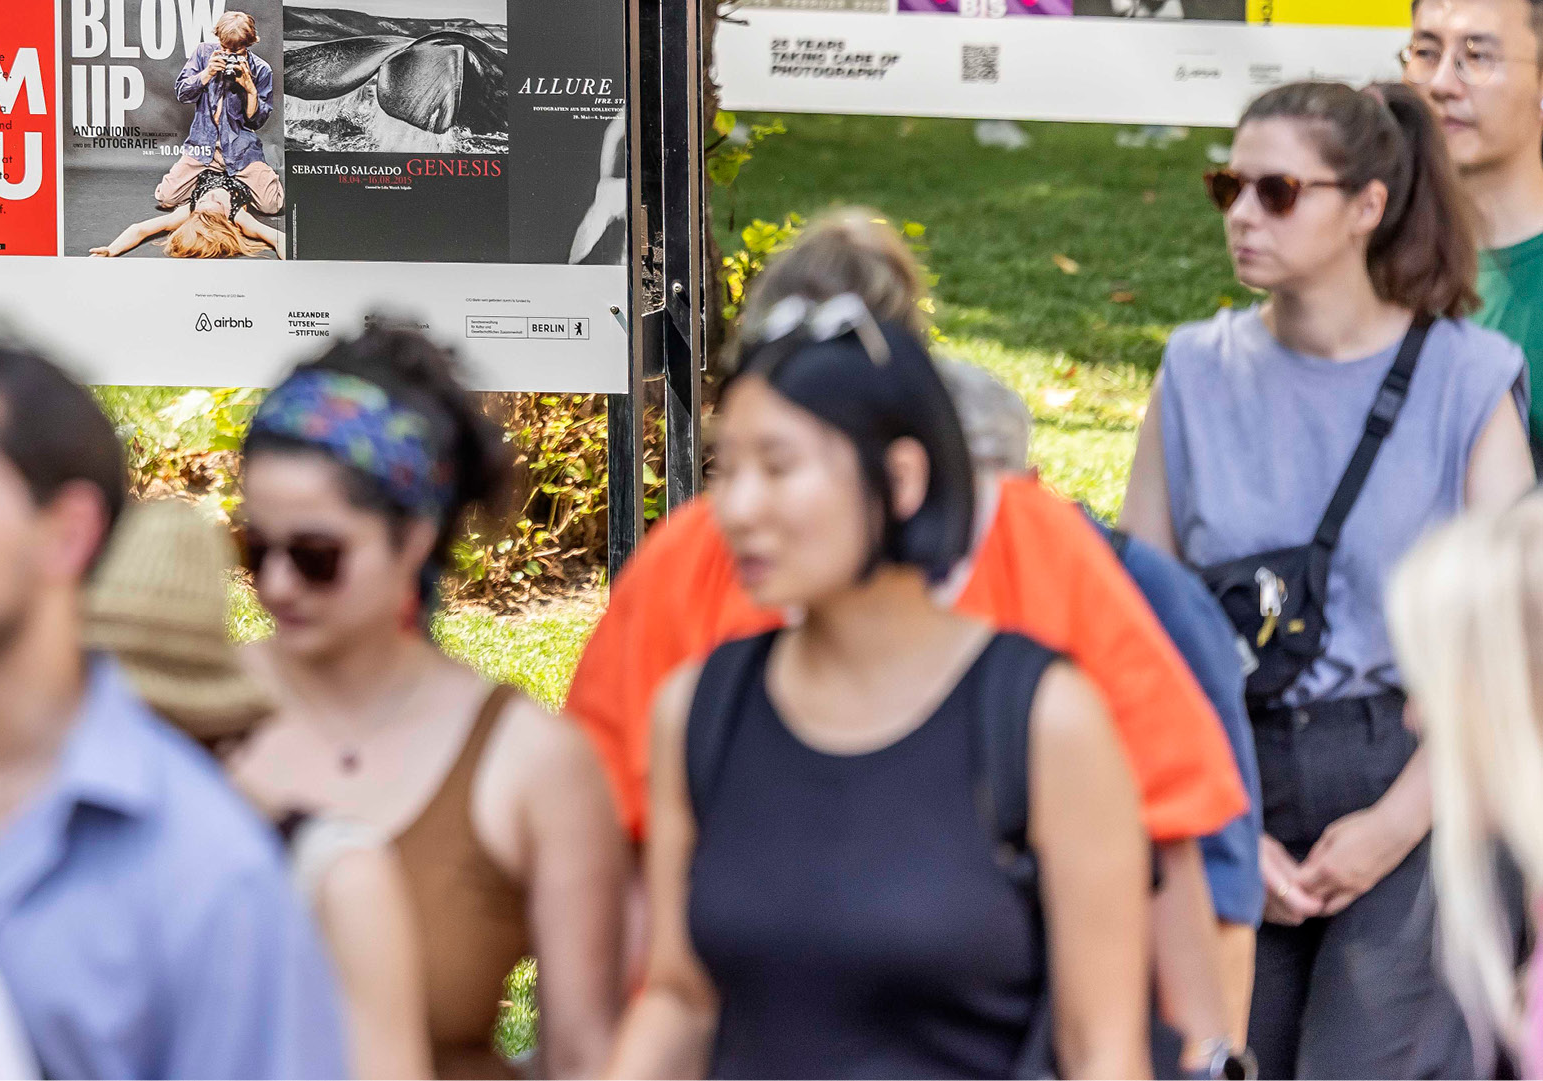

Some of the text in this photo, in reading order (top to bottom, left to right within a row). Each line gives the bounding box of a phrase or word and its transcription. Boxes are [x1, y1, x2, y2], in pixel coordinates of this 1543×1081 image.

[517, 77, 613, 95] ALLURE
[72, 64, 145, 138] UP
[73, 126, 141, 137] ANTONIONIS
[92, 138, 158, 149] FOTOGRAFIE
[351, 165, 402, 176] SALGADO
[406, 158, 502, 177] GENESIS
[288, 311, 330, 319] ALEXANDER
[213, 317, 253, 328] airbnb
[532, 323, 565, 333] BERLIN
